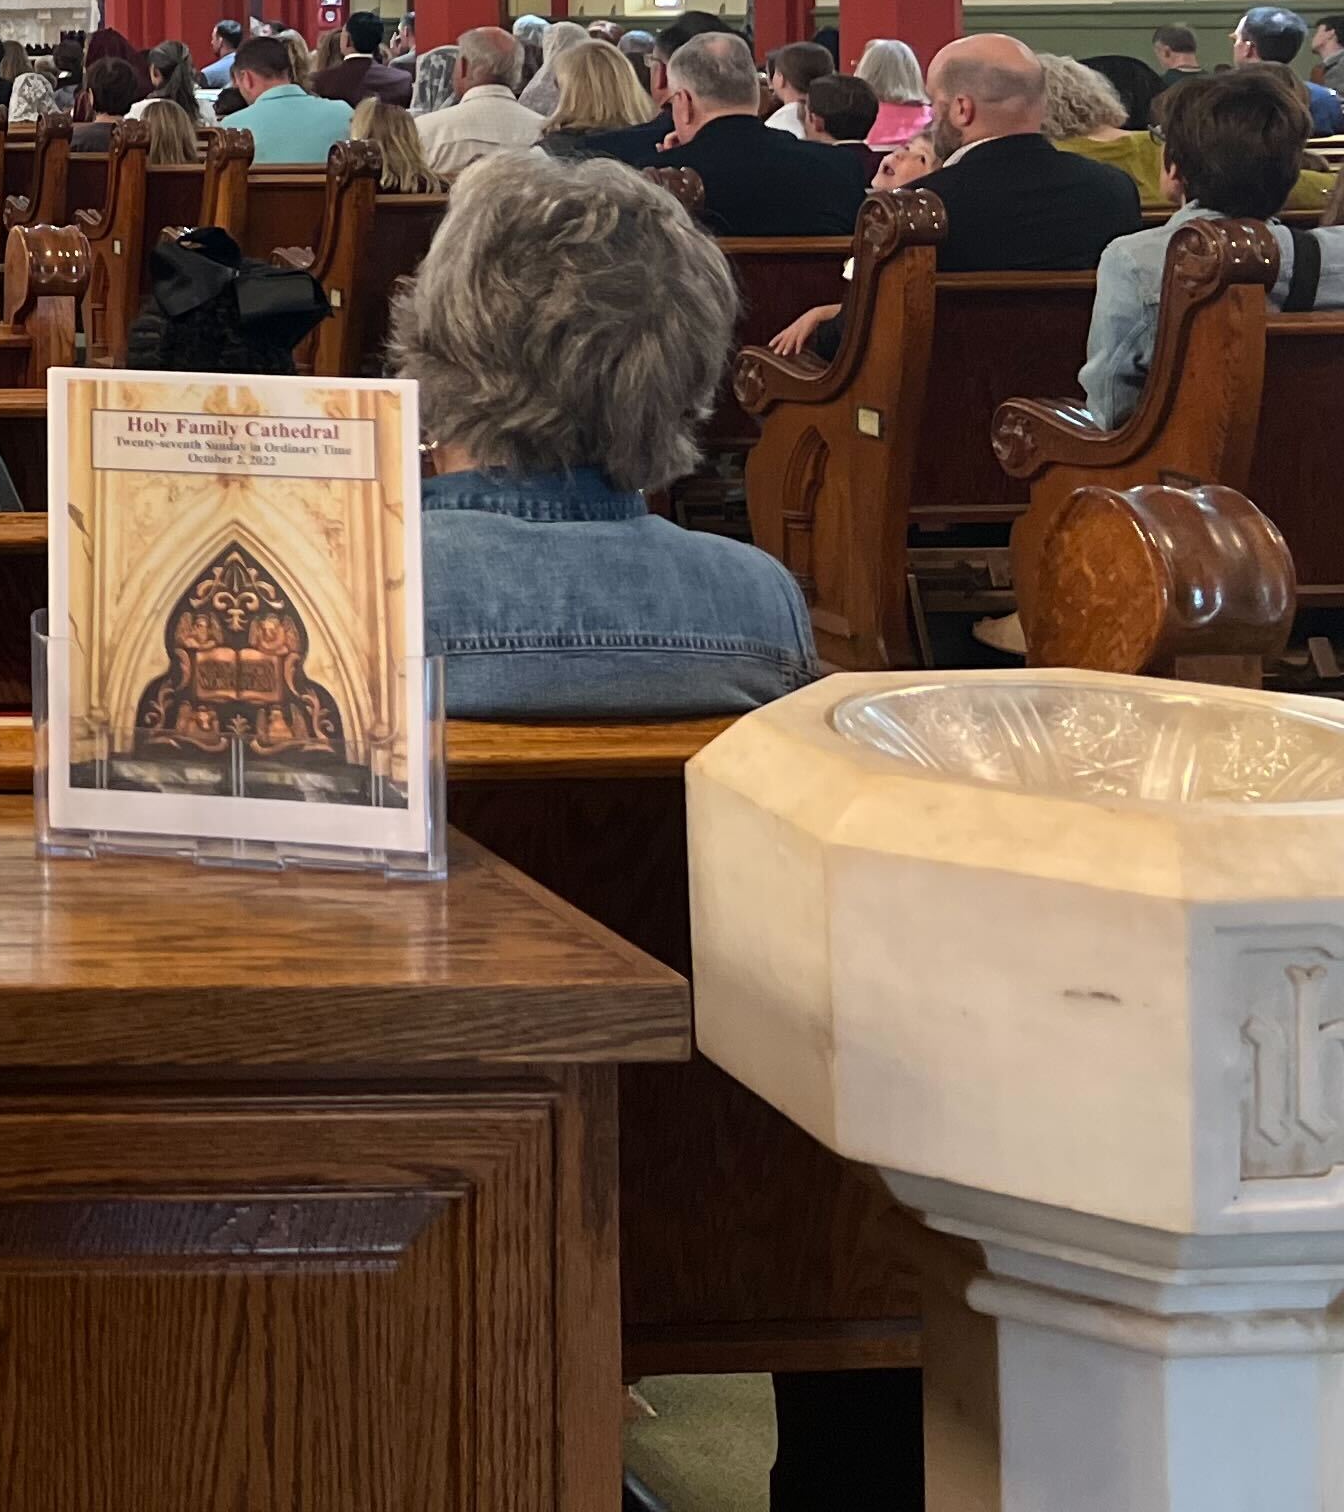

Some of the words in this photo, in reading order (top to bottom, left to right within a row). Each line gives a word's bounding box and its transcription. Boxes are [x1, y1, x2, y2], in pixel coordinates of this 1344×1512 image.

[127, 416, 169, 437] Holy
[176, 418, 238, 442] Family
[245, 421, 340, 439] Cathedral
[114, 436, 201, 450] Twenty-seventh
[205, 440, 247, 454] Sunday
[250, 441, 261, 452] in
[264, 443, 318, 456] Ordinary
[323, 444, 352, 455] Time
[188, 453, 232, 465] October
[250, 455, 276, 466] 2022
